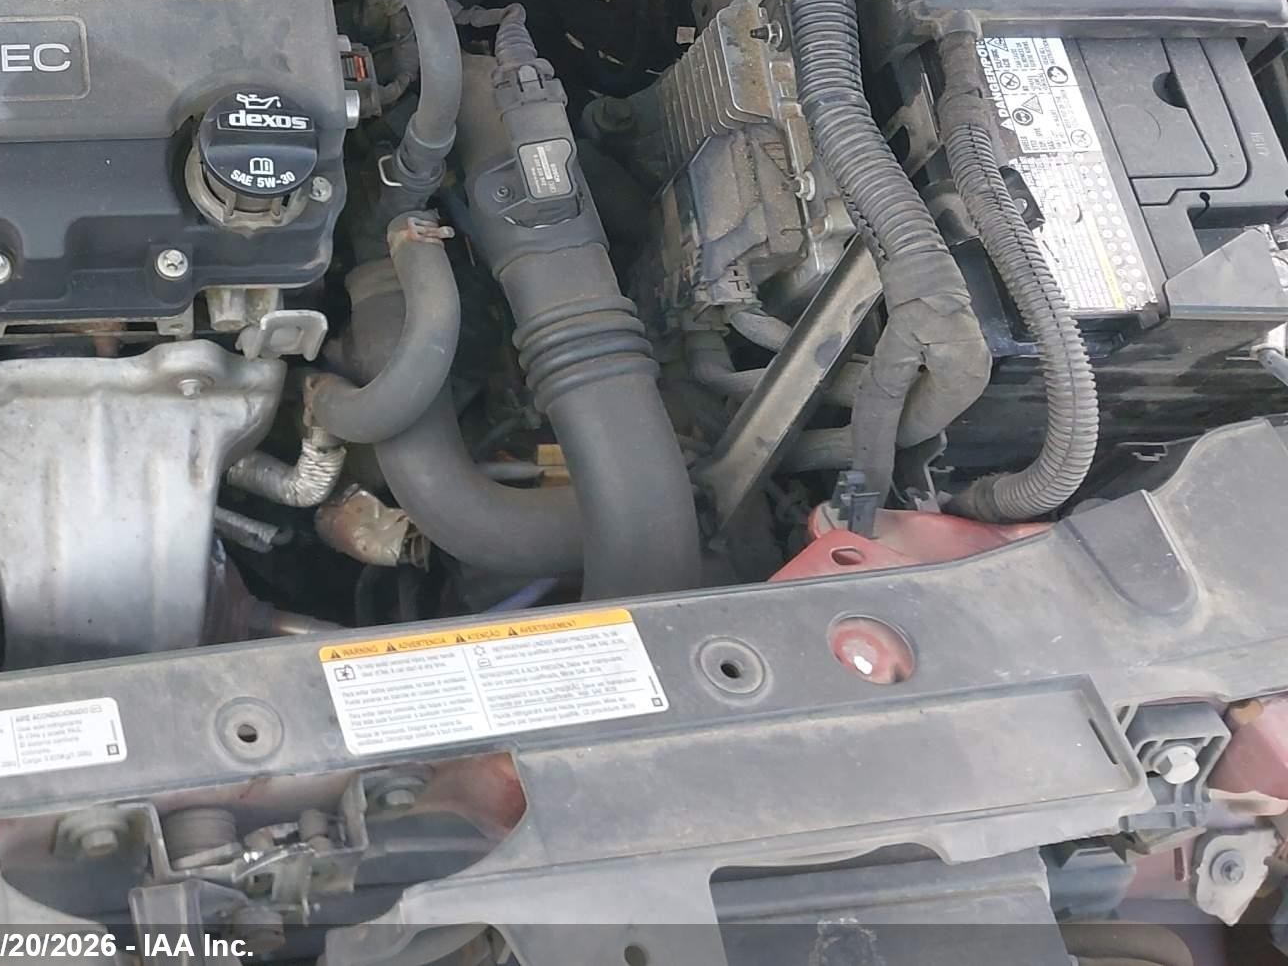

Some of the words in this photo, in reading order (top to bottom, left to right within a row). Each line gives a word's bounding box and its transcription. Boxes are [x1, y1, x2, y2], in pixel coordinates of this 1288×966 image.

[228, 109, 310, 130] dexos
[230, 169, 254, 187] SAE
[256, 171, 296, 188] 5W-30
